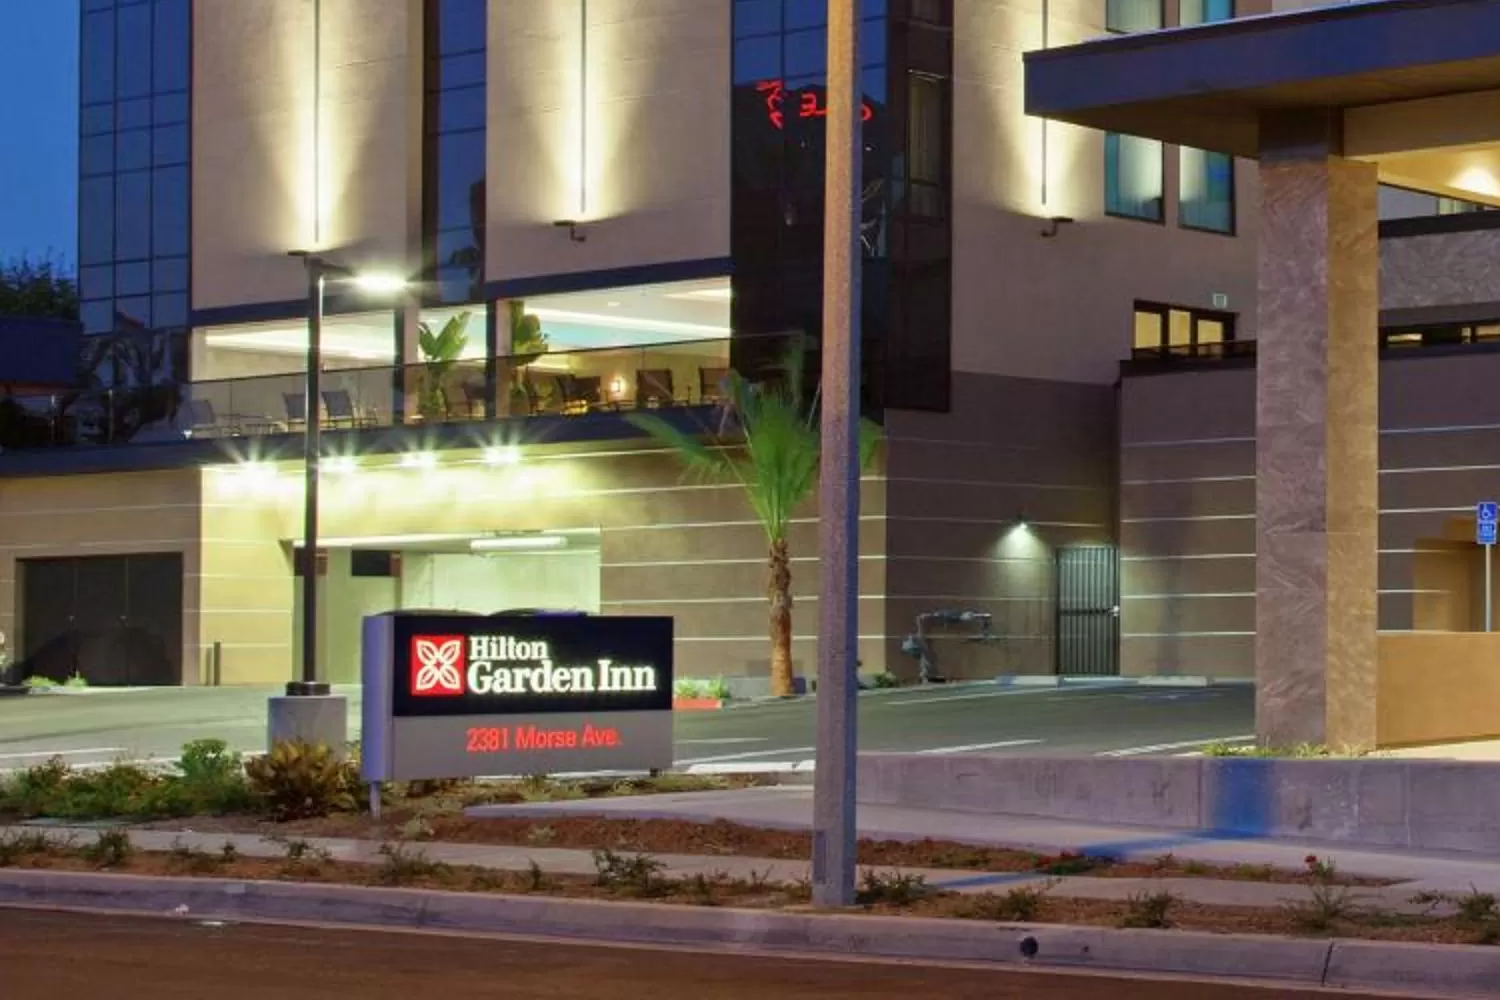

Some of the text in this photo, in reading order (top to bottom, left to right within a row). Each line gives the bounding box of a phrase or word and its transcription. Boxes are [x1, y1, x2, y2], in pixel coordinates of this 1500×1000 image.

[468, 635, 549, 661] Hilton
[467, 658, 657, 694] Garden Inn
[466, 722, 622, 752] 2381 Morse Ave.
